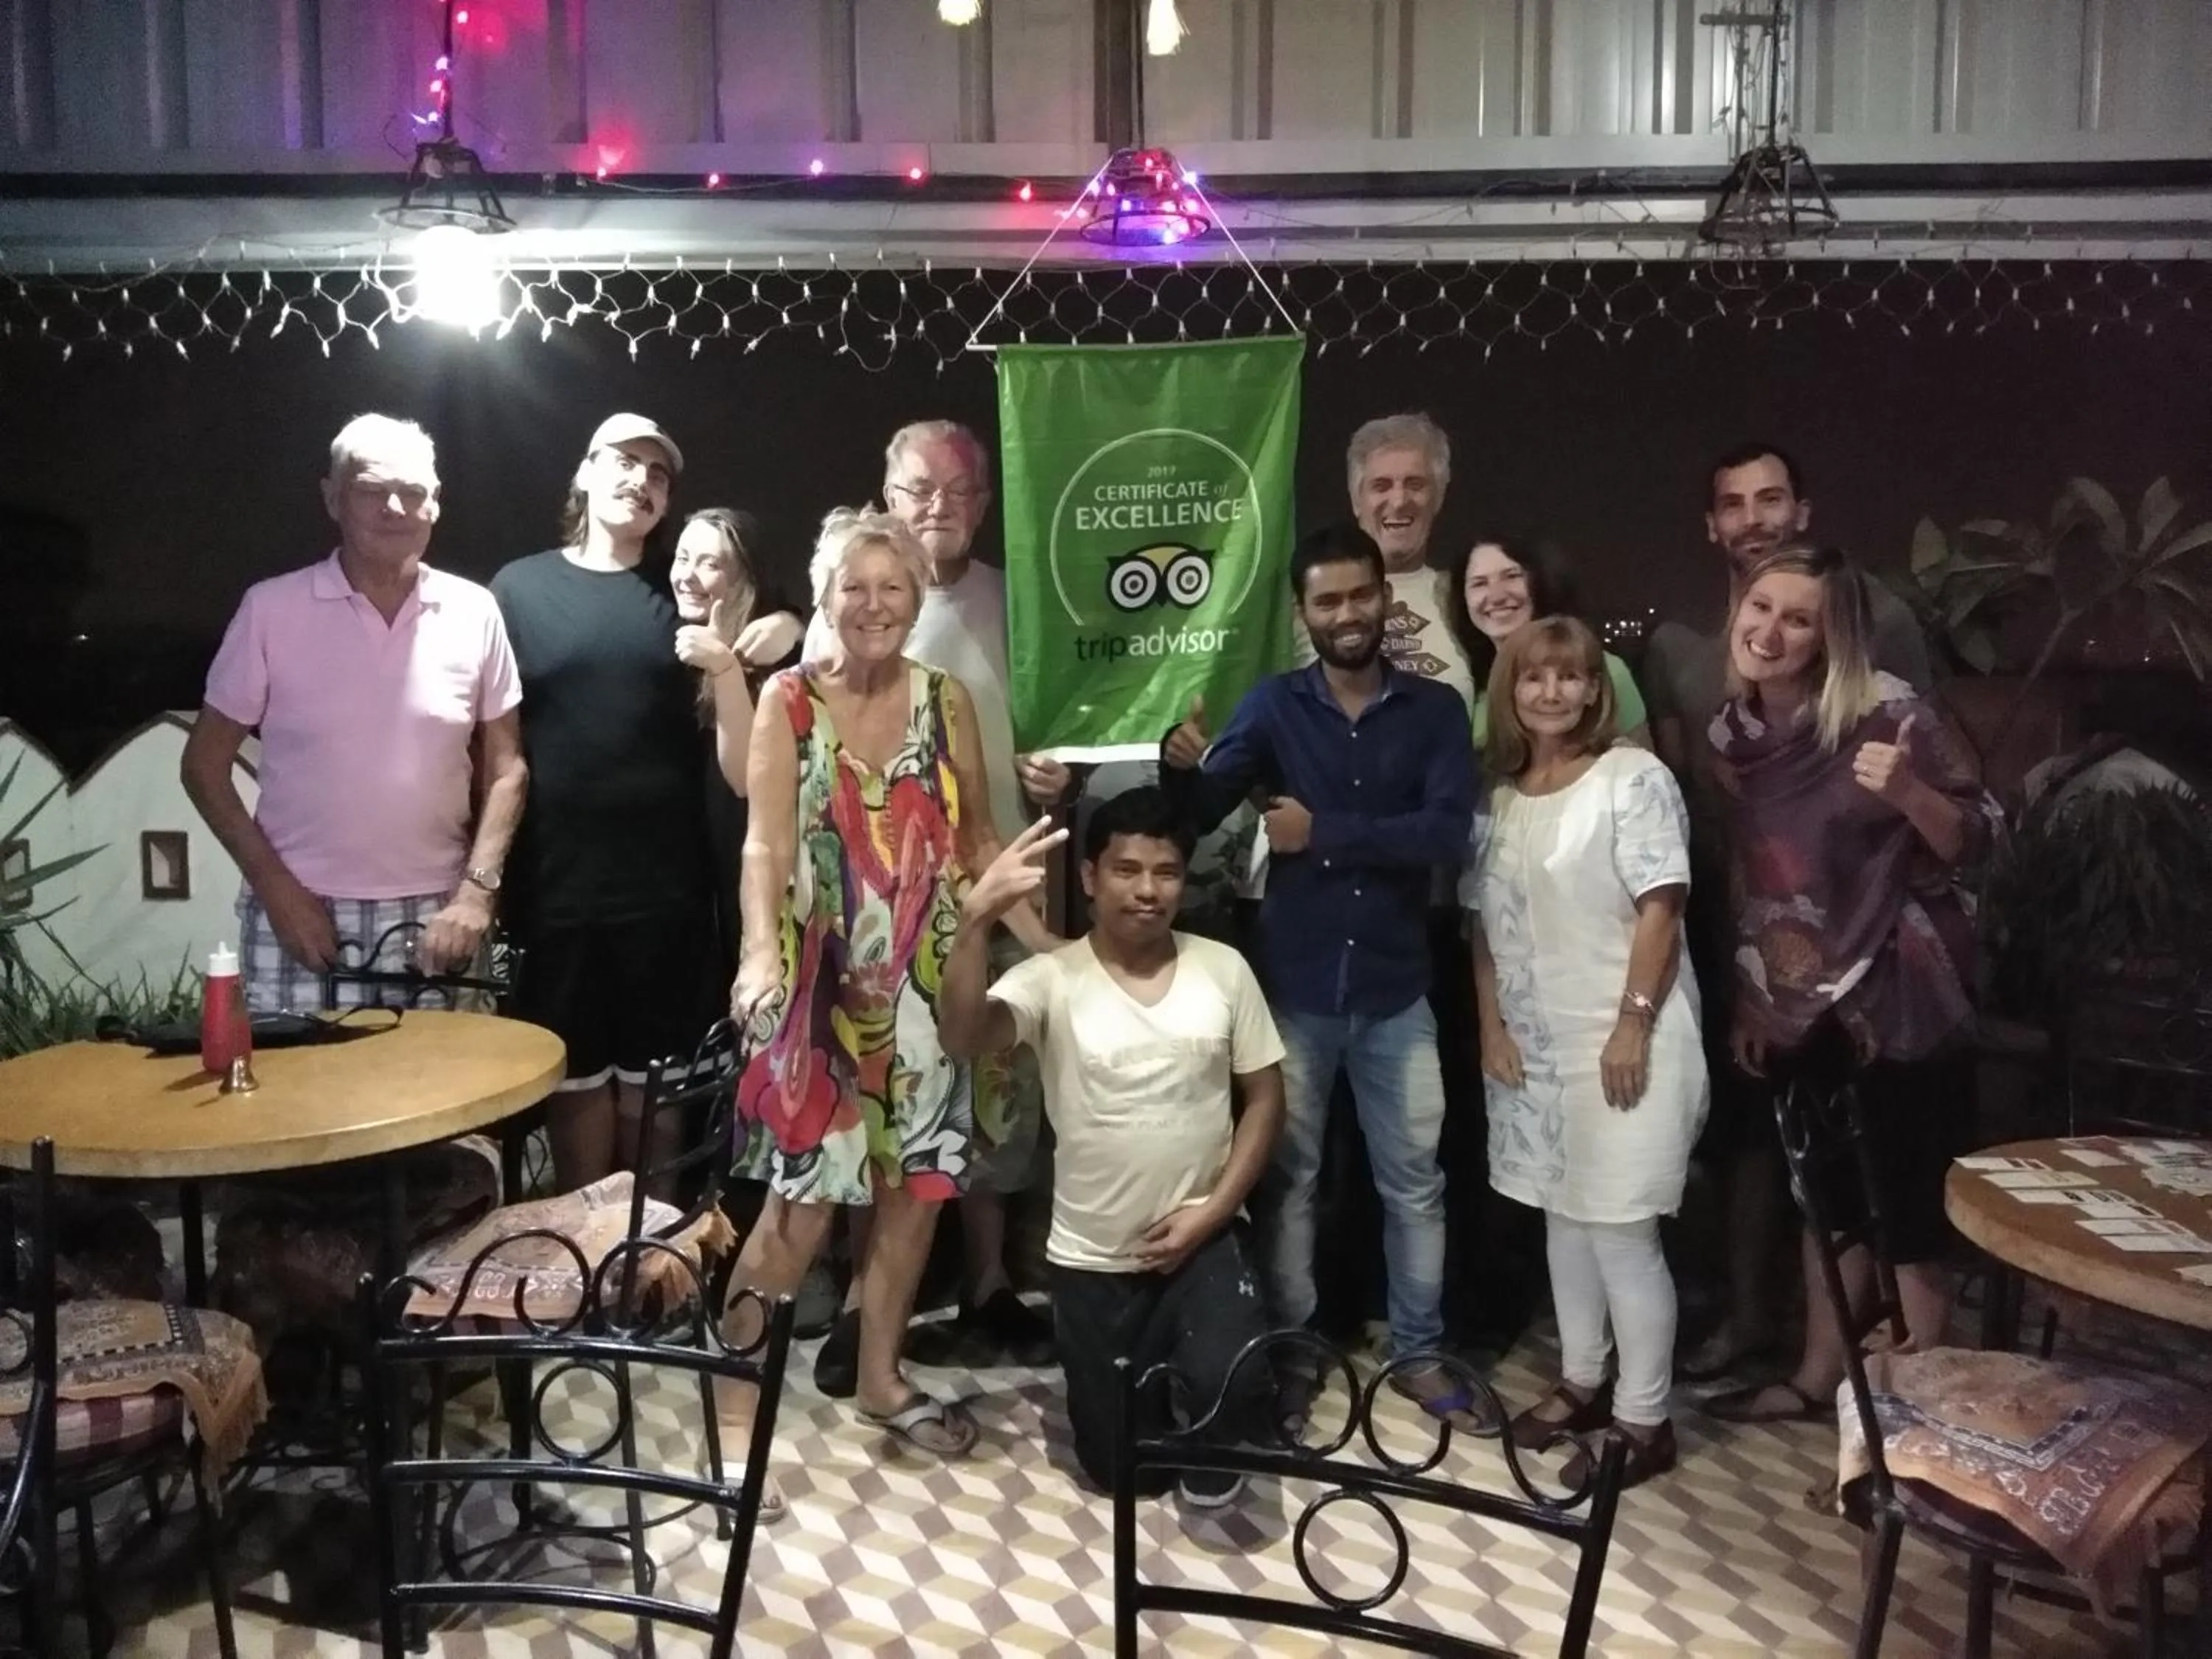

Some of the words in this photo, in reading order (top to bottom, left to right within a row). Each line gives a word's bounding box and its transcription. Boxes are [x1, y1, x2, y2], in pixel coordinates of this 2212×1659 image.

[1147, 465, 1177, 479] 2017
[1094, 480, 1209, 501] CERTIFICATE
[1213, 484, 1228, 498] of
[1076, 498, 1246, 530] EXCELLENCE
[1074, 625, 1229, 663] tripadvisor
